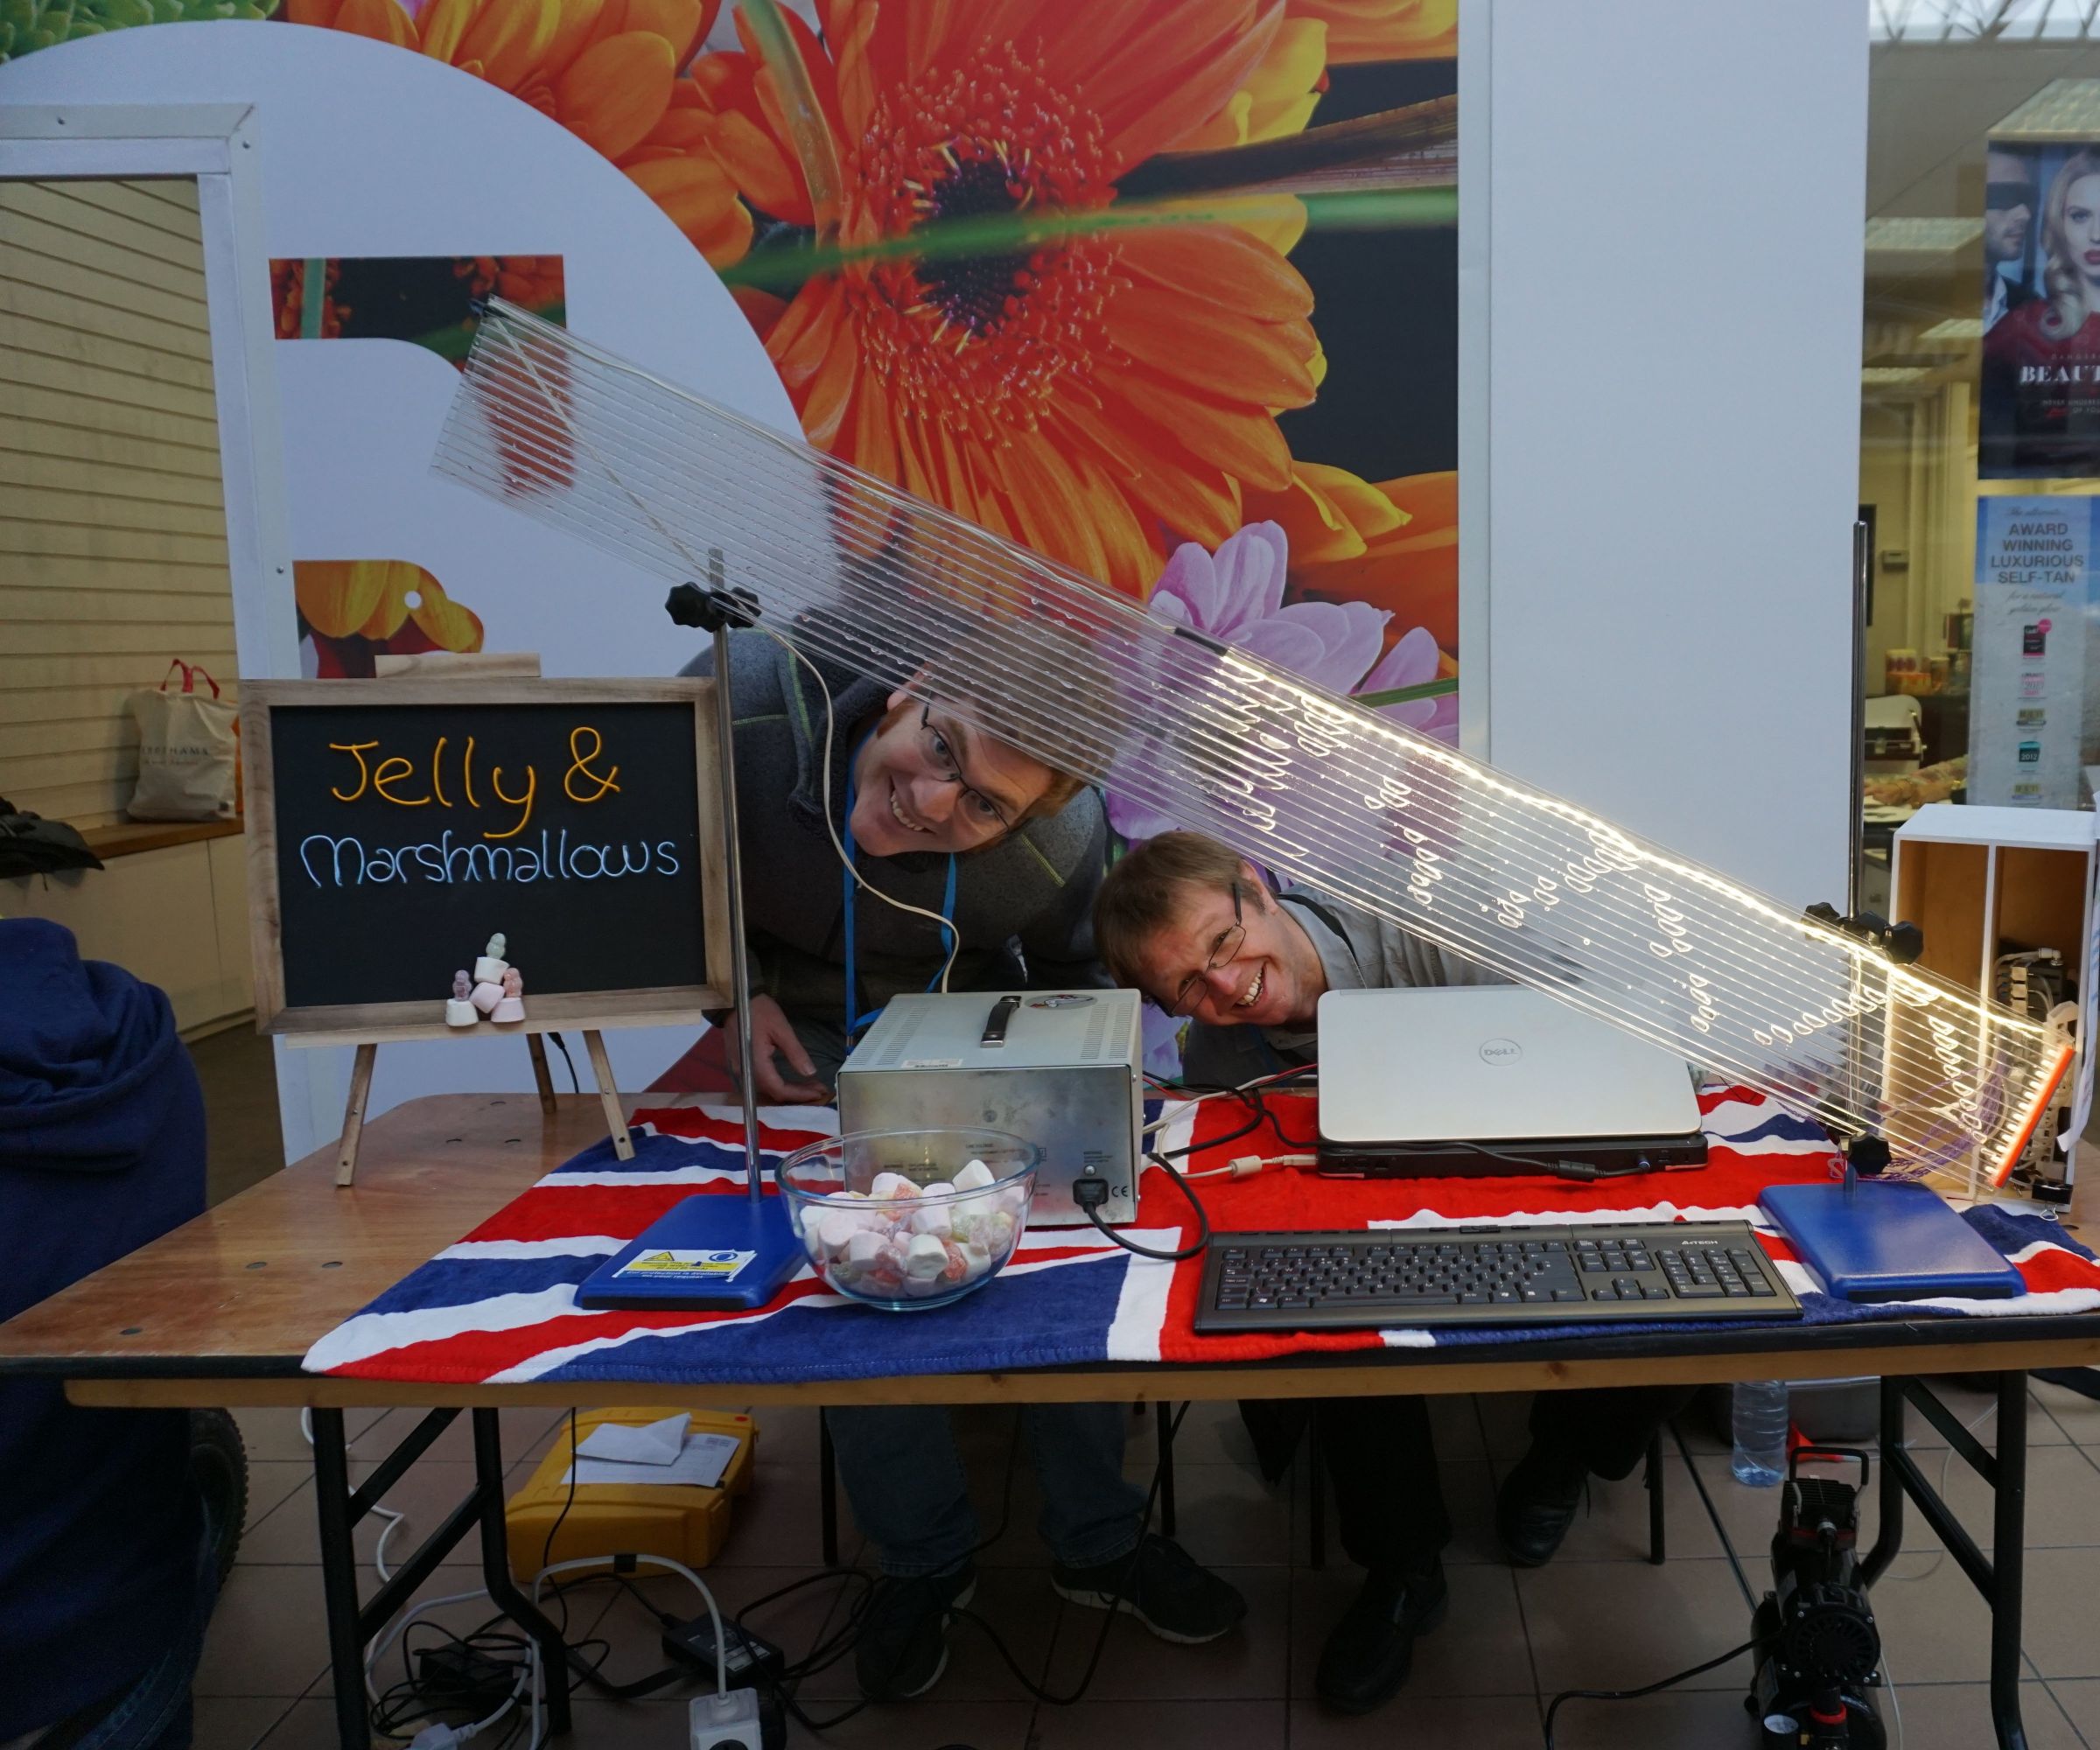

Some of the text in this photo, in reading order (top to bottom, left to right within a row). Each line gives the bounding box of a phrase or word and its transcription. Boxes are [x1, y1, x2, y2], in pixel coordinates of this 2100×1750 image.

[2009, 523, 2068, 536] AWARD
[2003, 539, 2074, 551] WINNING
[1991, 555, 2084, 568] LUXURIOUS
[1998, 571, 2076, 584] SELF-TAN
[329, 726, 620, 838] Jelly &
[300, 829, 679, 888] Marshmallows
